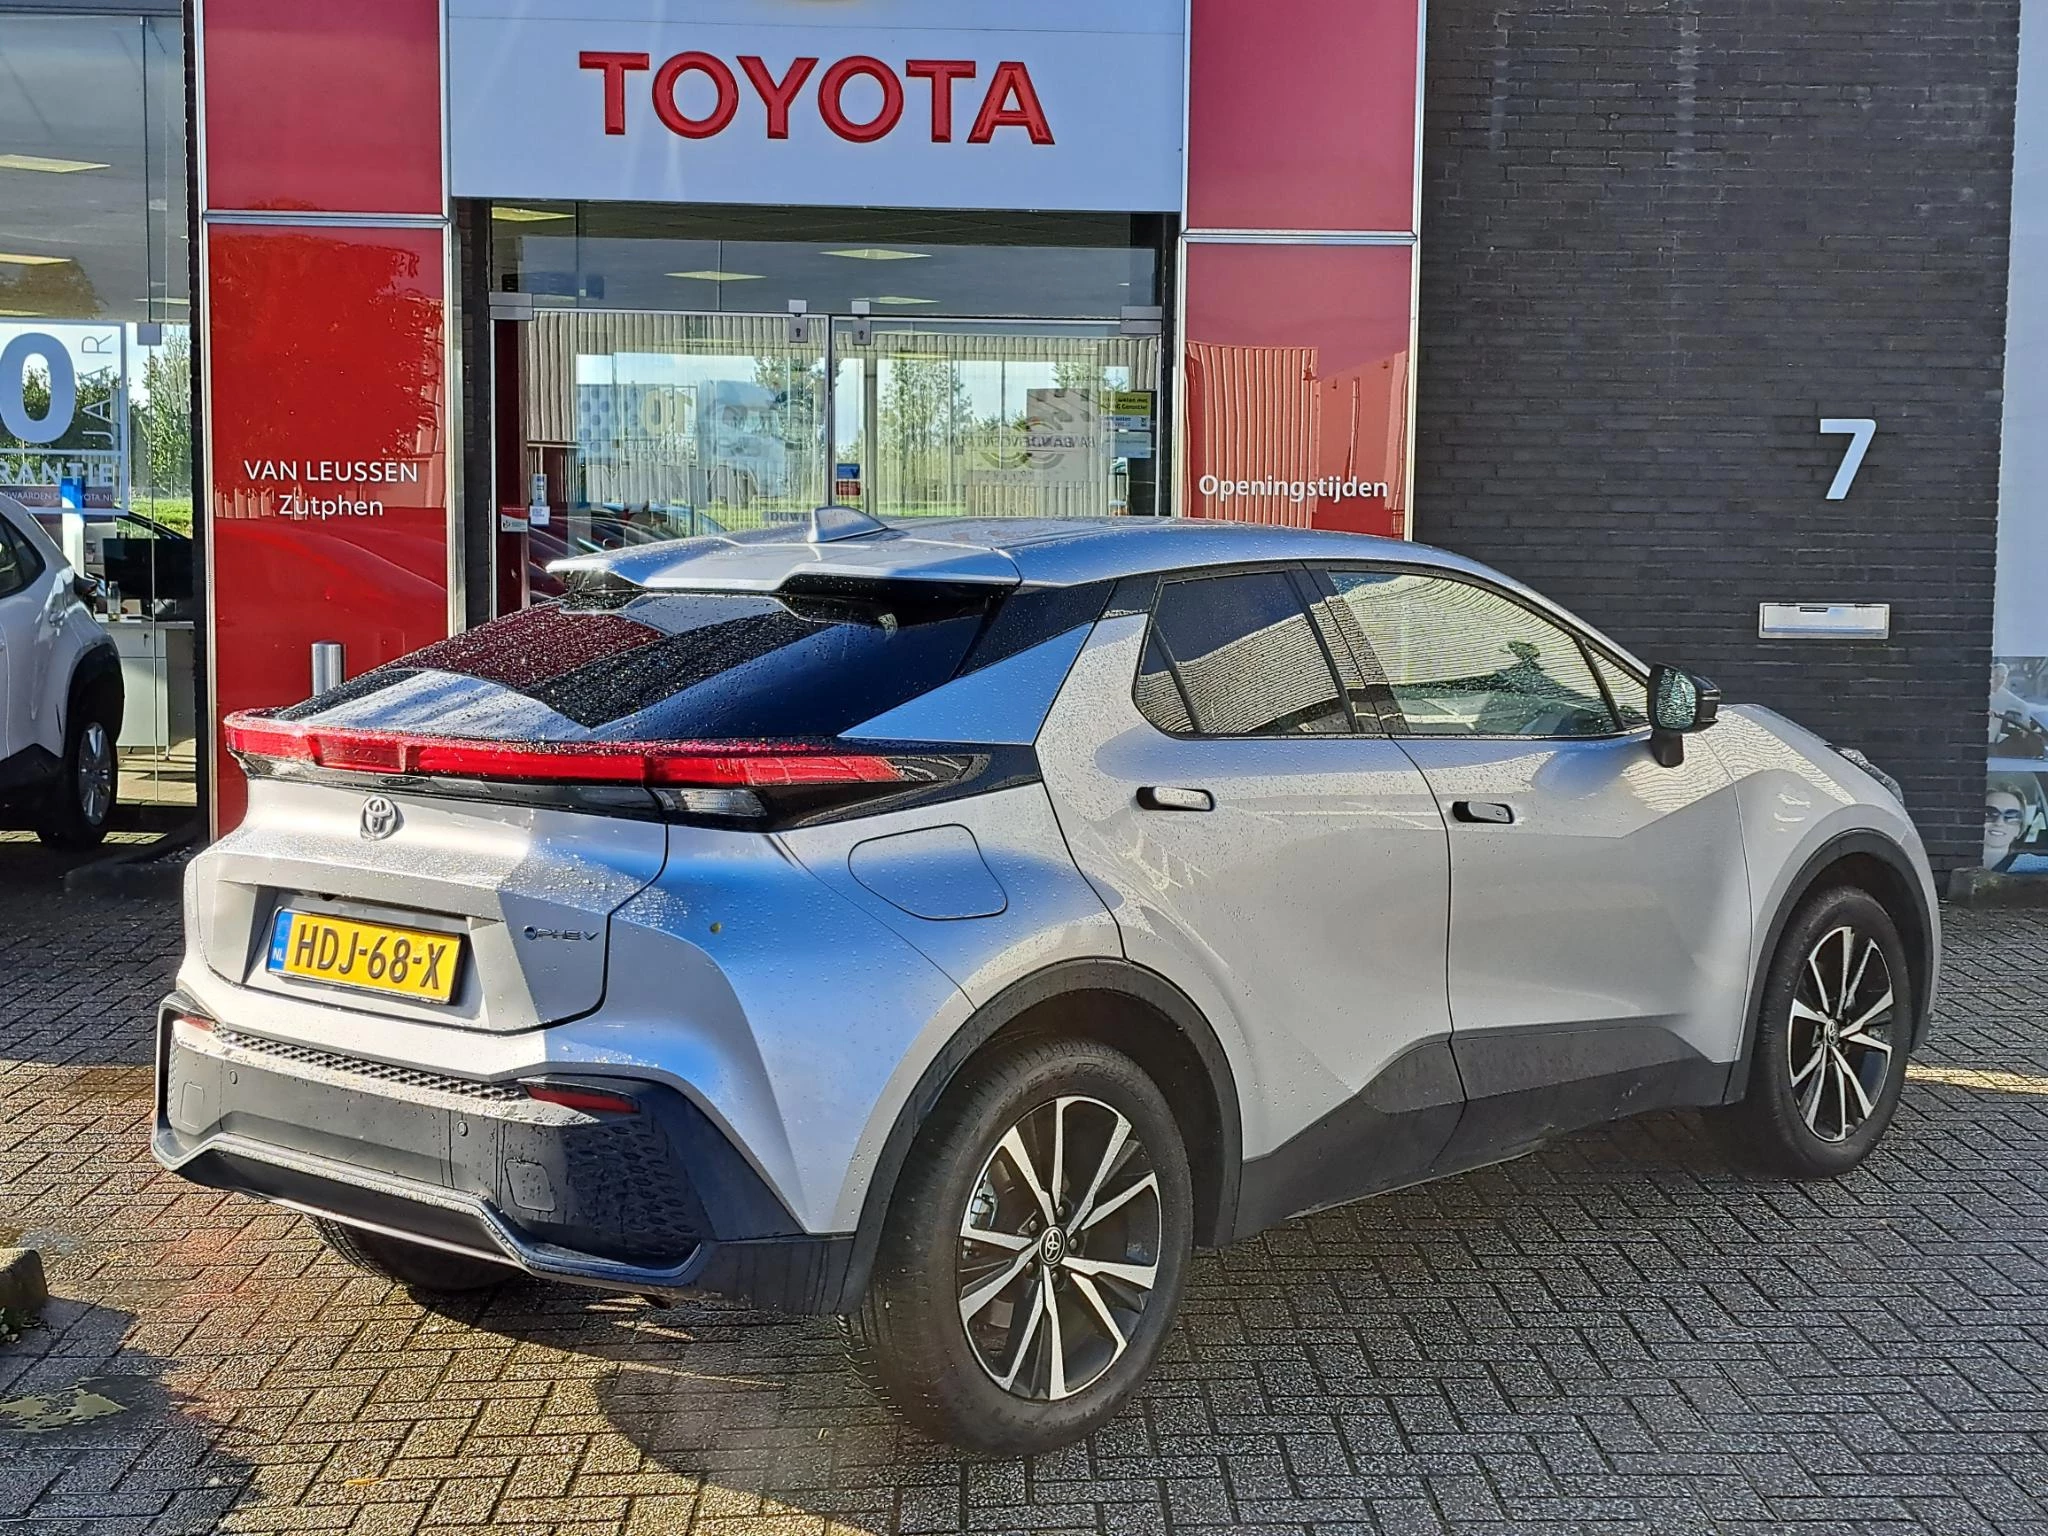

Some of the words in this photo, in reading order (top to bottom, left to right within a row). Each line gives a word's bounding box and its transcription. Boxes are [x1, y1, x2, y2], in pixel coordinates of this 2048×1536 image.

[578, 50, 1056, 145] TOYOTA
[244, 460, 297, 480] VAN
[306, 460, 418, 482] LEUSSEN
[1819, 418, 1877, 500] 7
[1199, 475, 1388, 503] Openingstijden
[279, 494, 384, 520] Zutphen
[537, 928, 600, 942] PHEV
[272, 947, 285, 962] NL
[293, 922, 447, 991] HDJ-68-X
